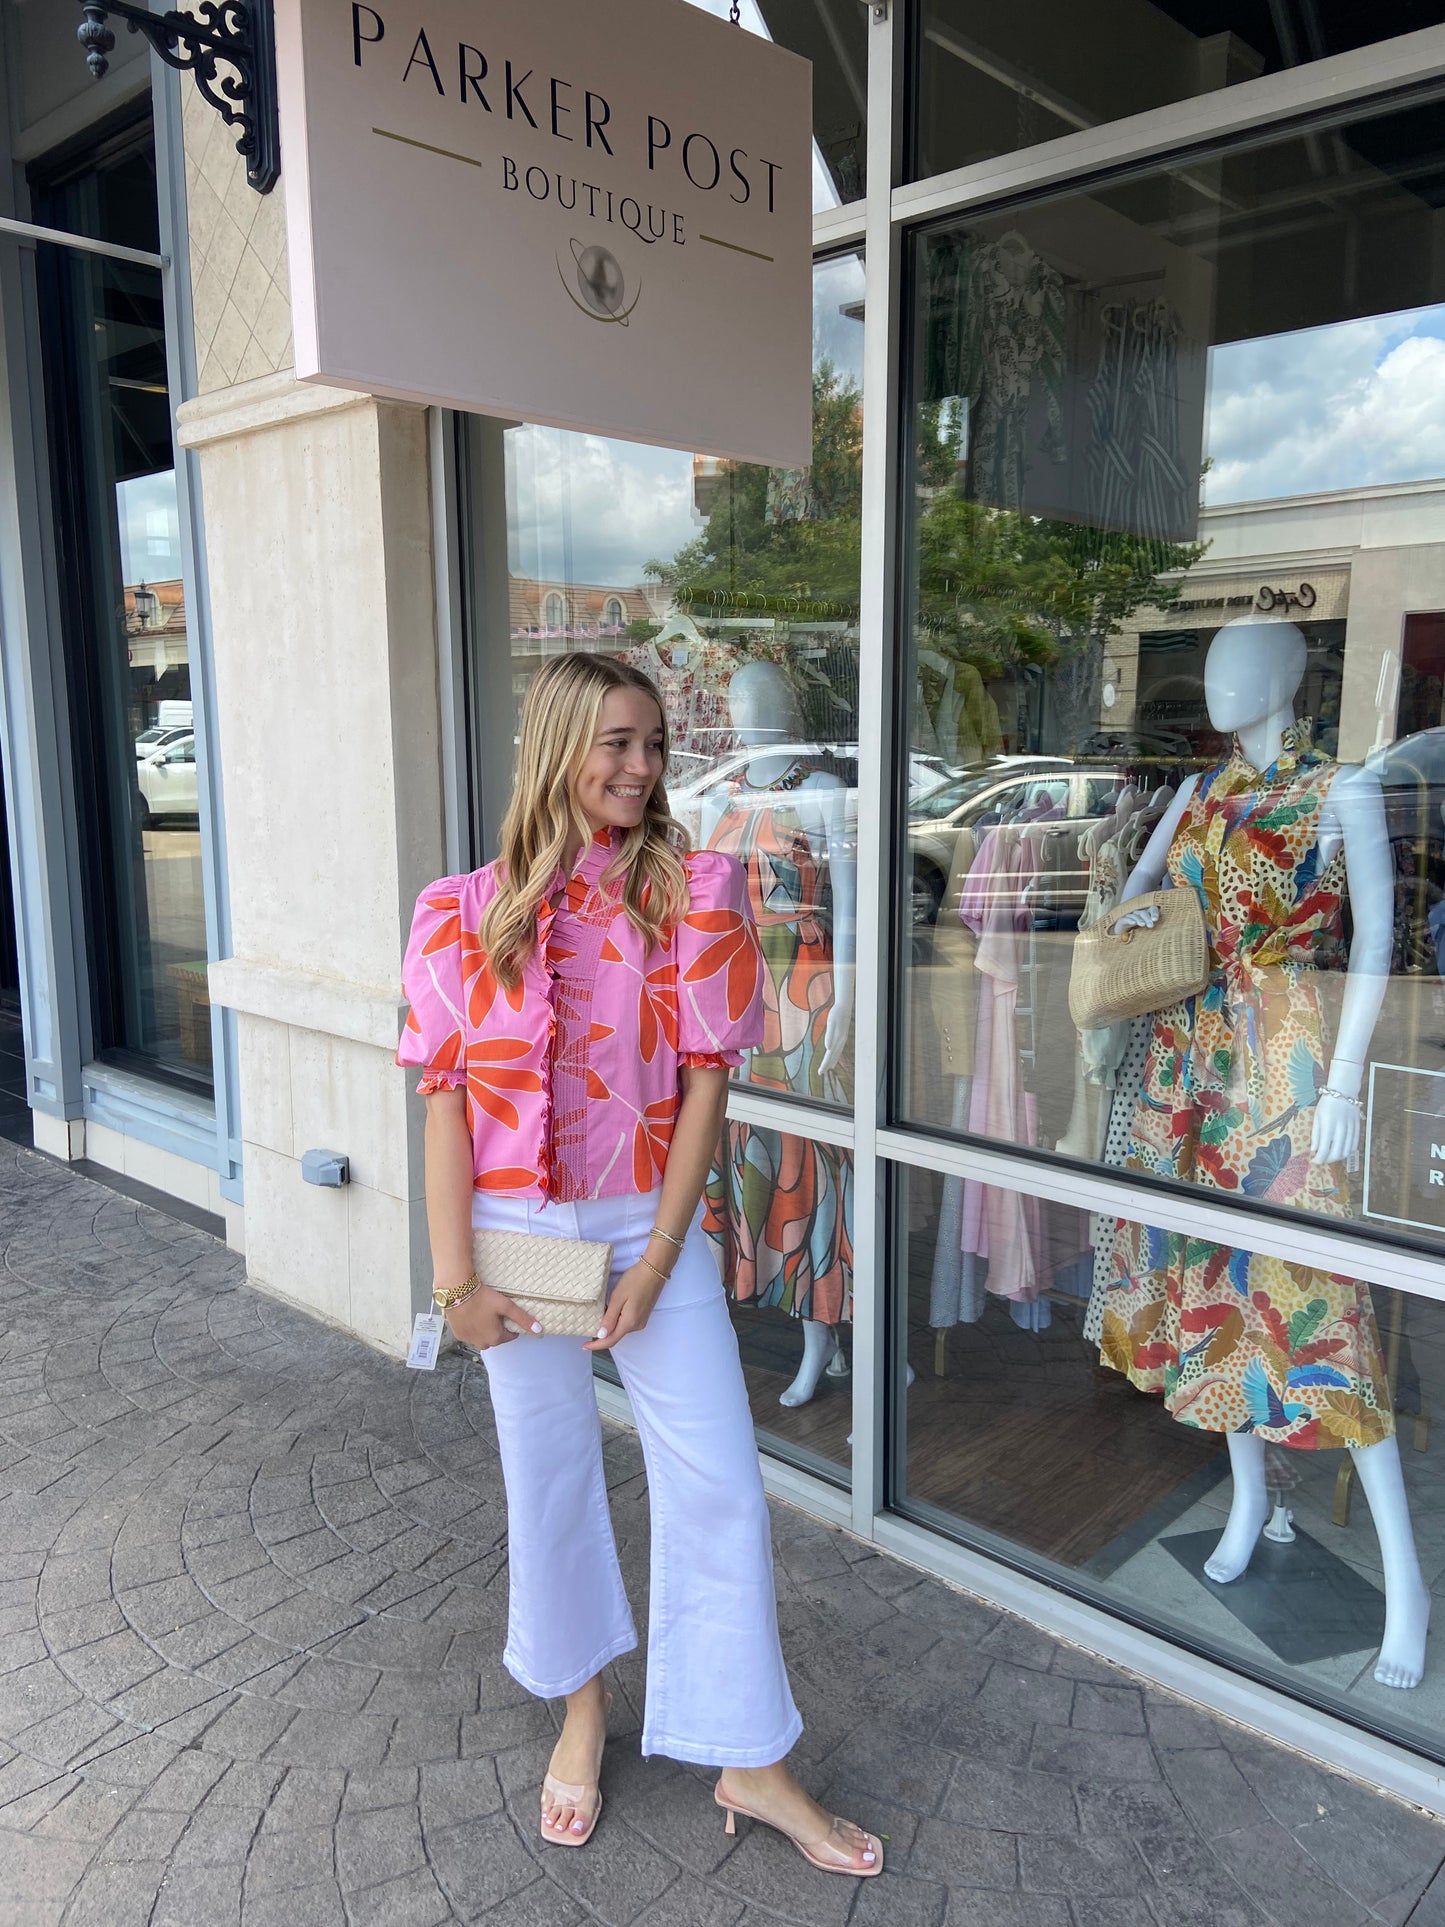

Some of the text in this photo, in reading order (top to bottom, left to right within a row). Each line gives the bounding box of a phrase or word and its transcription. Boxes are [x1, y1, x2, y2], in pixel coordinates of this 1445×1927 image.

[351, 2, 783, 214] PARKER POST
[501, 156, 687, 246] BOUTIQUE
